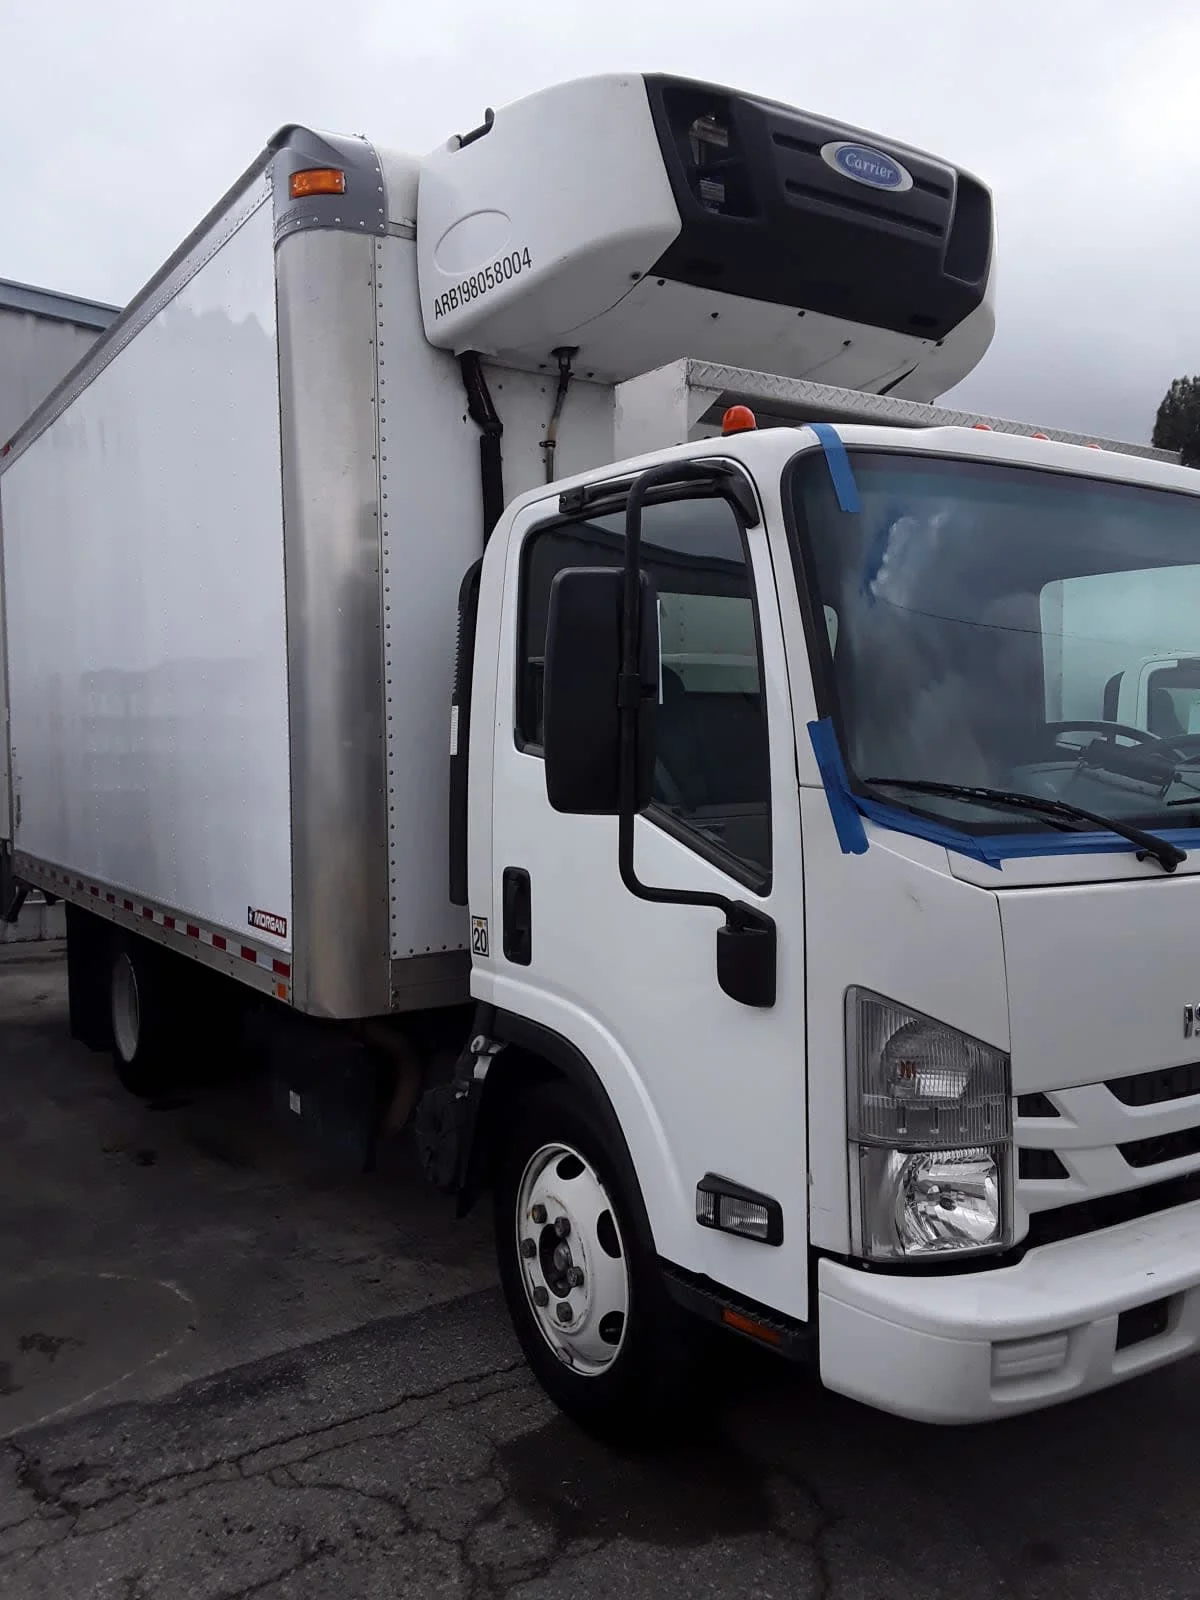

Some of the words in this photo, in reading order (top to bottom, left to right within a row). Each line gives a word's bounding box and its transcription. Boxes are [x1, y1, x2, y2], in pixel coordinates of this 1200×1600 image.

[845, 153, 893, 178] Carrier
[434, 247, 532, 320] ARB198058004
[253, 910, 286, 936] MORGAN
[474, 927, 487, 953] 20
